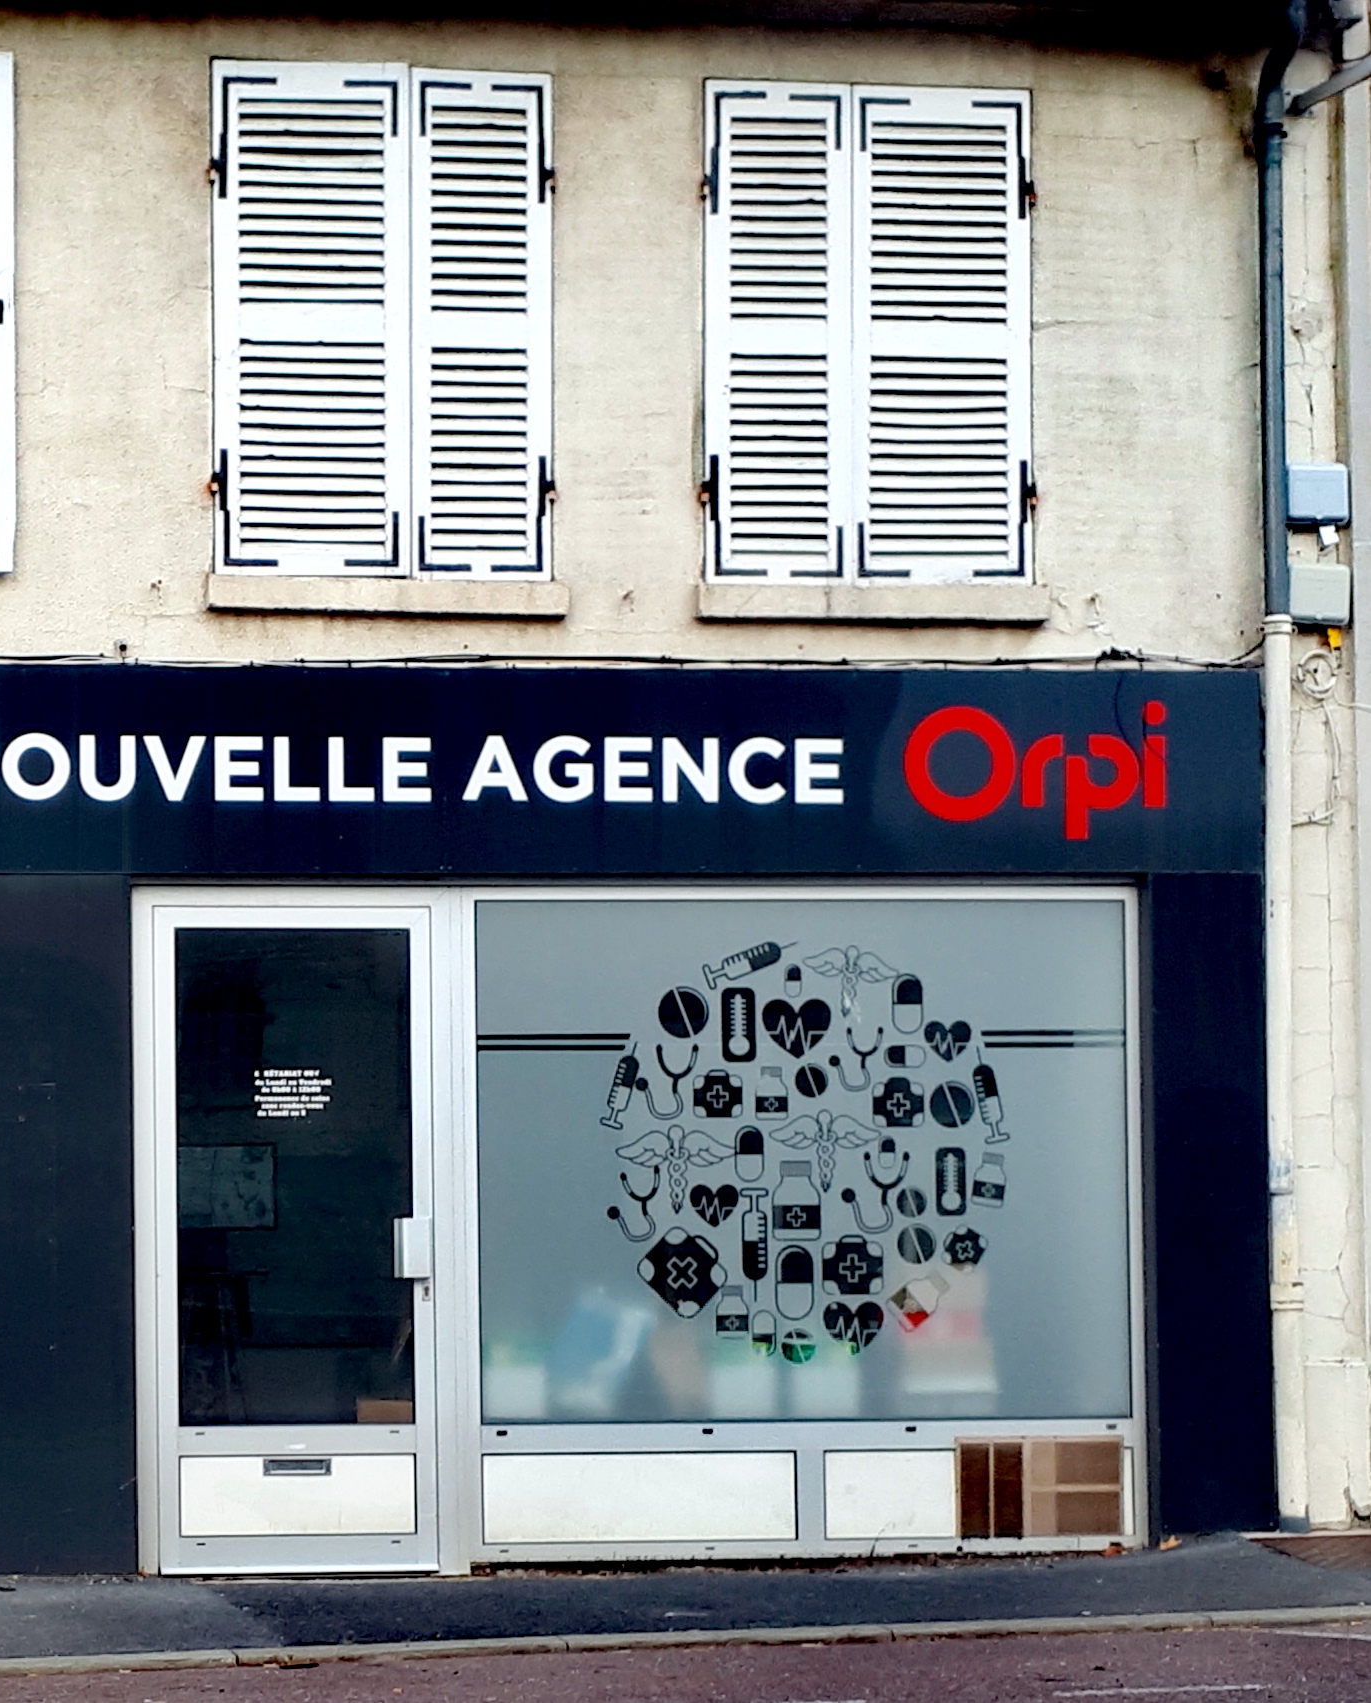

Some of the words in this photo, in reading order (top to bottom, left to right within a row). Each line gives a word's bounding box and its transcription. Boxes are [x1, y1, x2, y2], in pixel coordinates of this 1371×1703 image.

[462, 735, 844, 804] AGENCE
[902, 700, 1167, 841] Orpi
[266, 1078, 287, 1086] Lundi
[299, 1078, 332, 1086] Vendredi
[268, 1109, 289, 1117] Lundi
